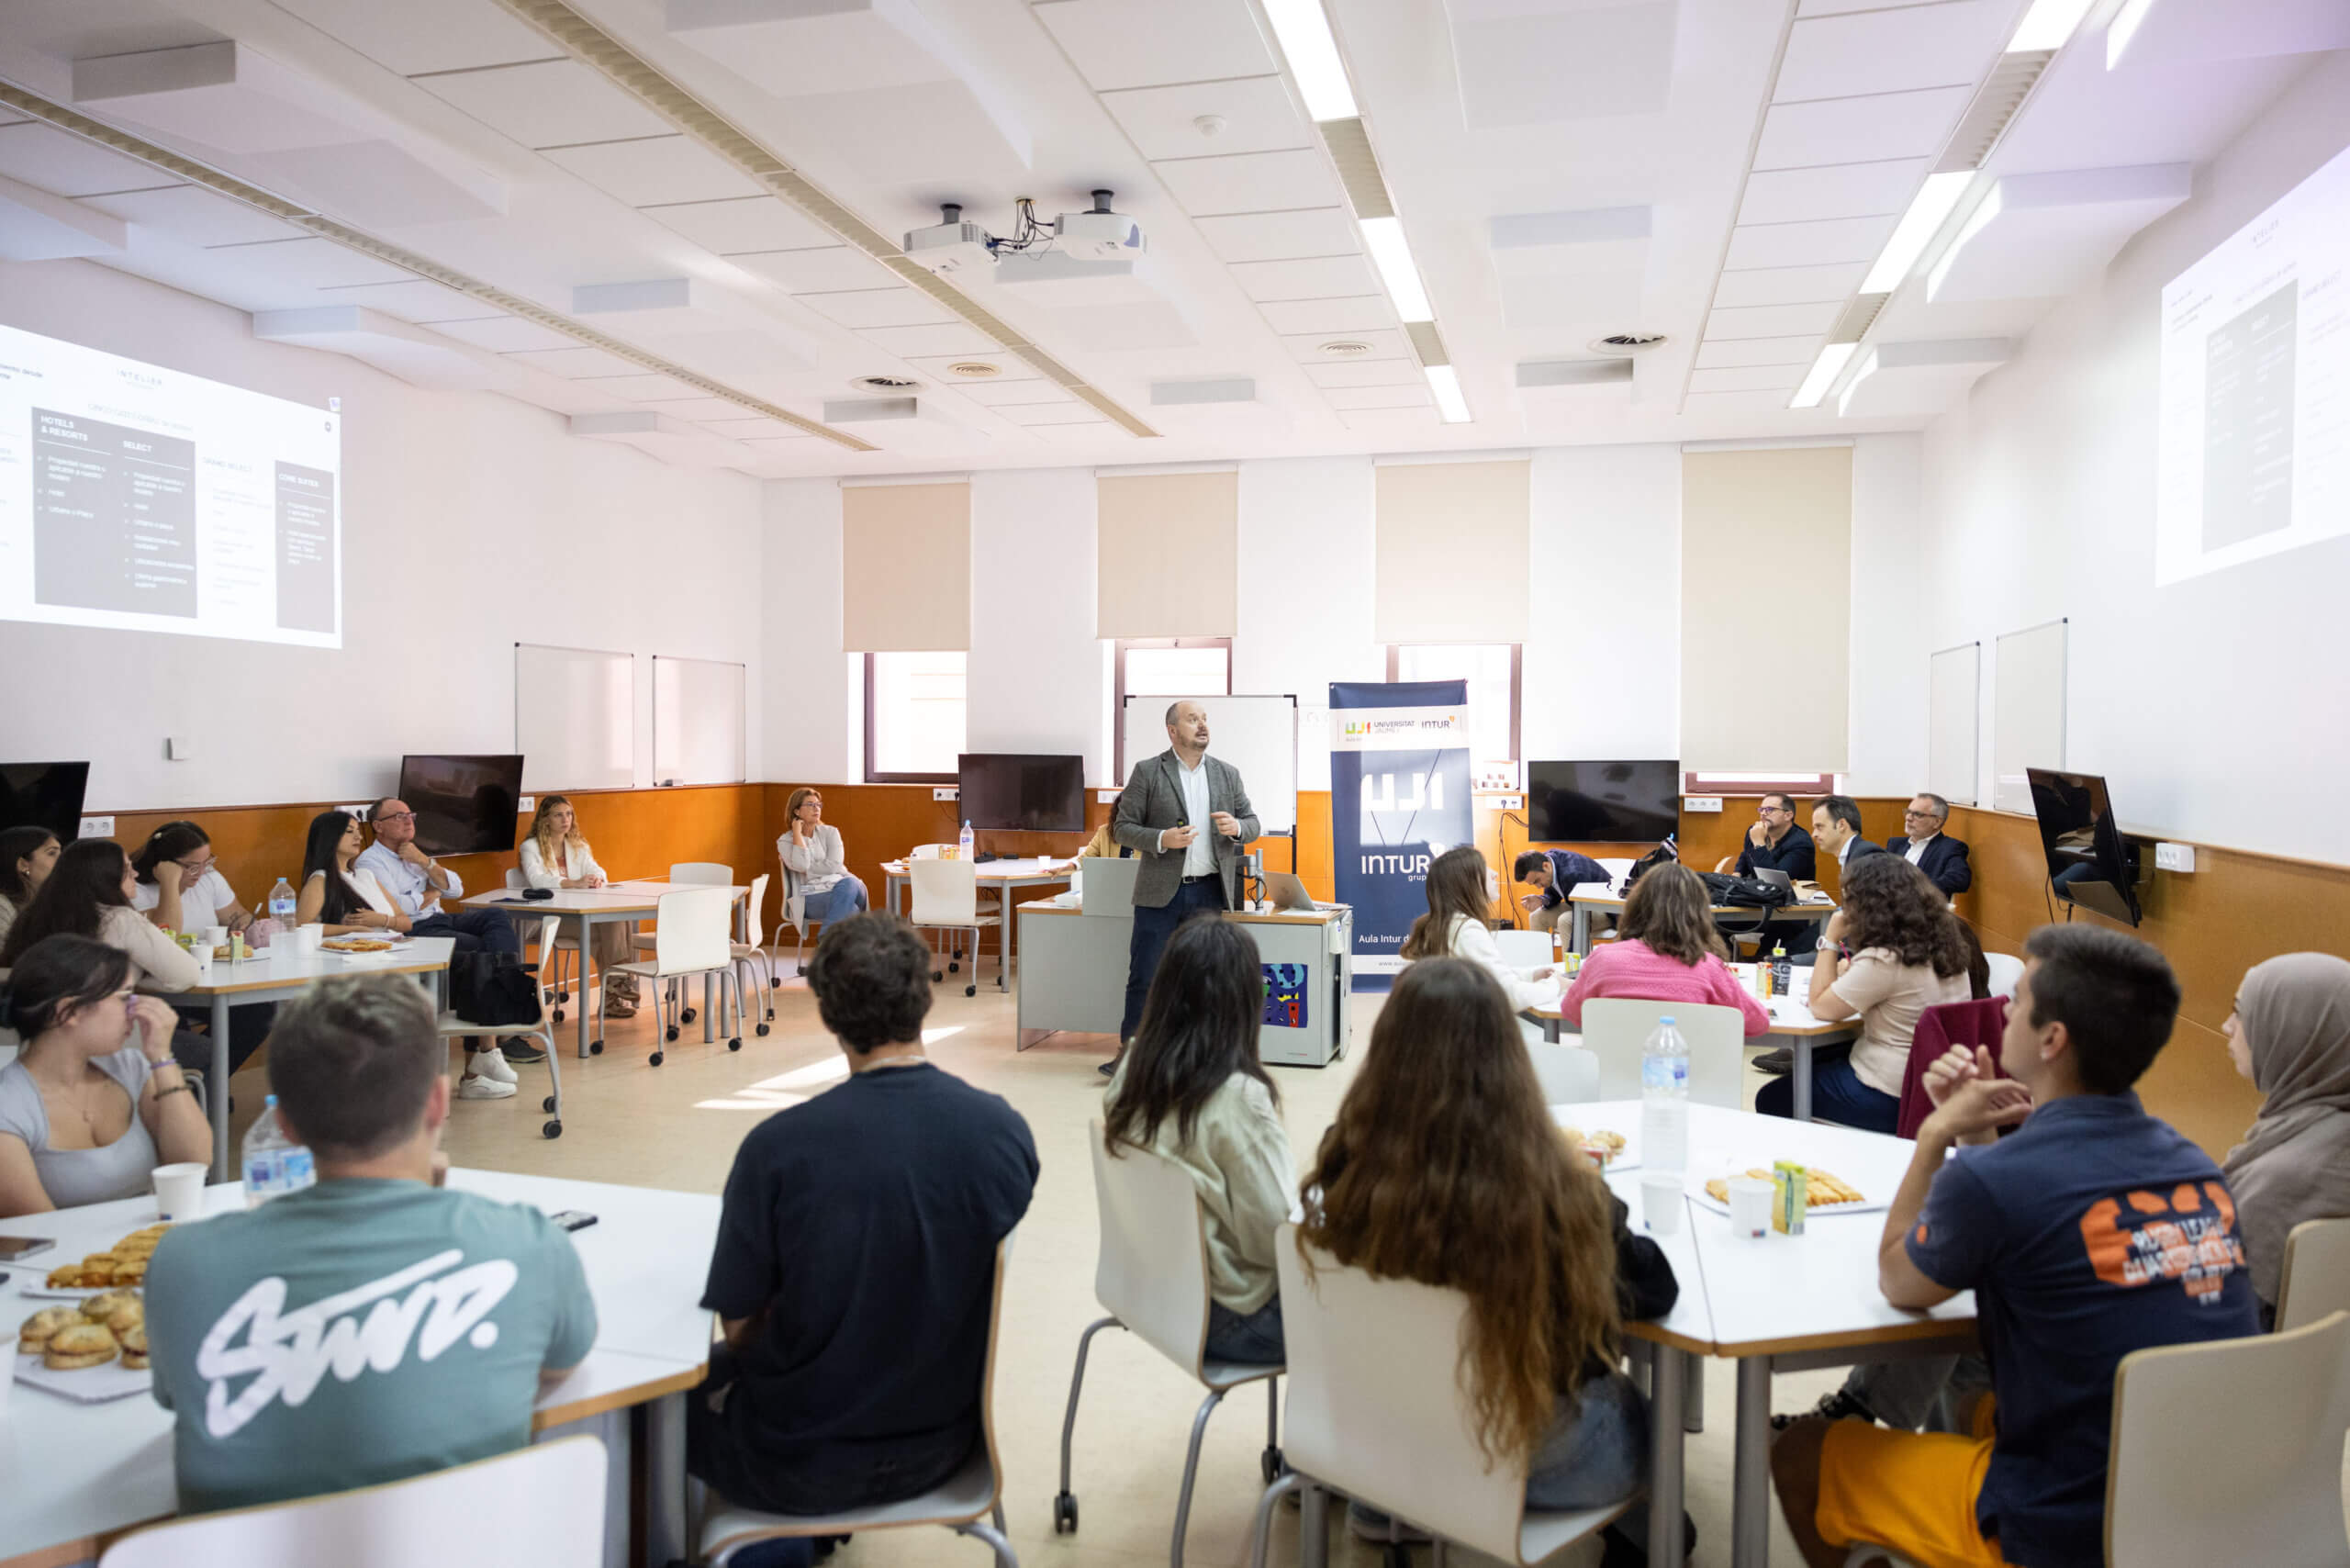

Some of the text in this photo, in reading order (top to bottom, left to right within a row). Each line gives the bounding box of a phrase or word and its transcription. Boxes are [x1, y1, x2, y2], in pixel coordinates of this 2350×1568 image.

[40, 415, 74, 429] HOTELS
[49, 426, 88, 442] RESORTS
[123, 440, 152, 453] SELECT
[1359, 934, 1378, 944] Aula
[1381, 934, 1401, 944] Intur
